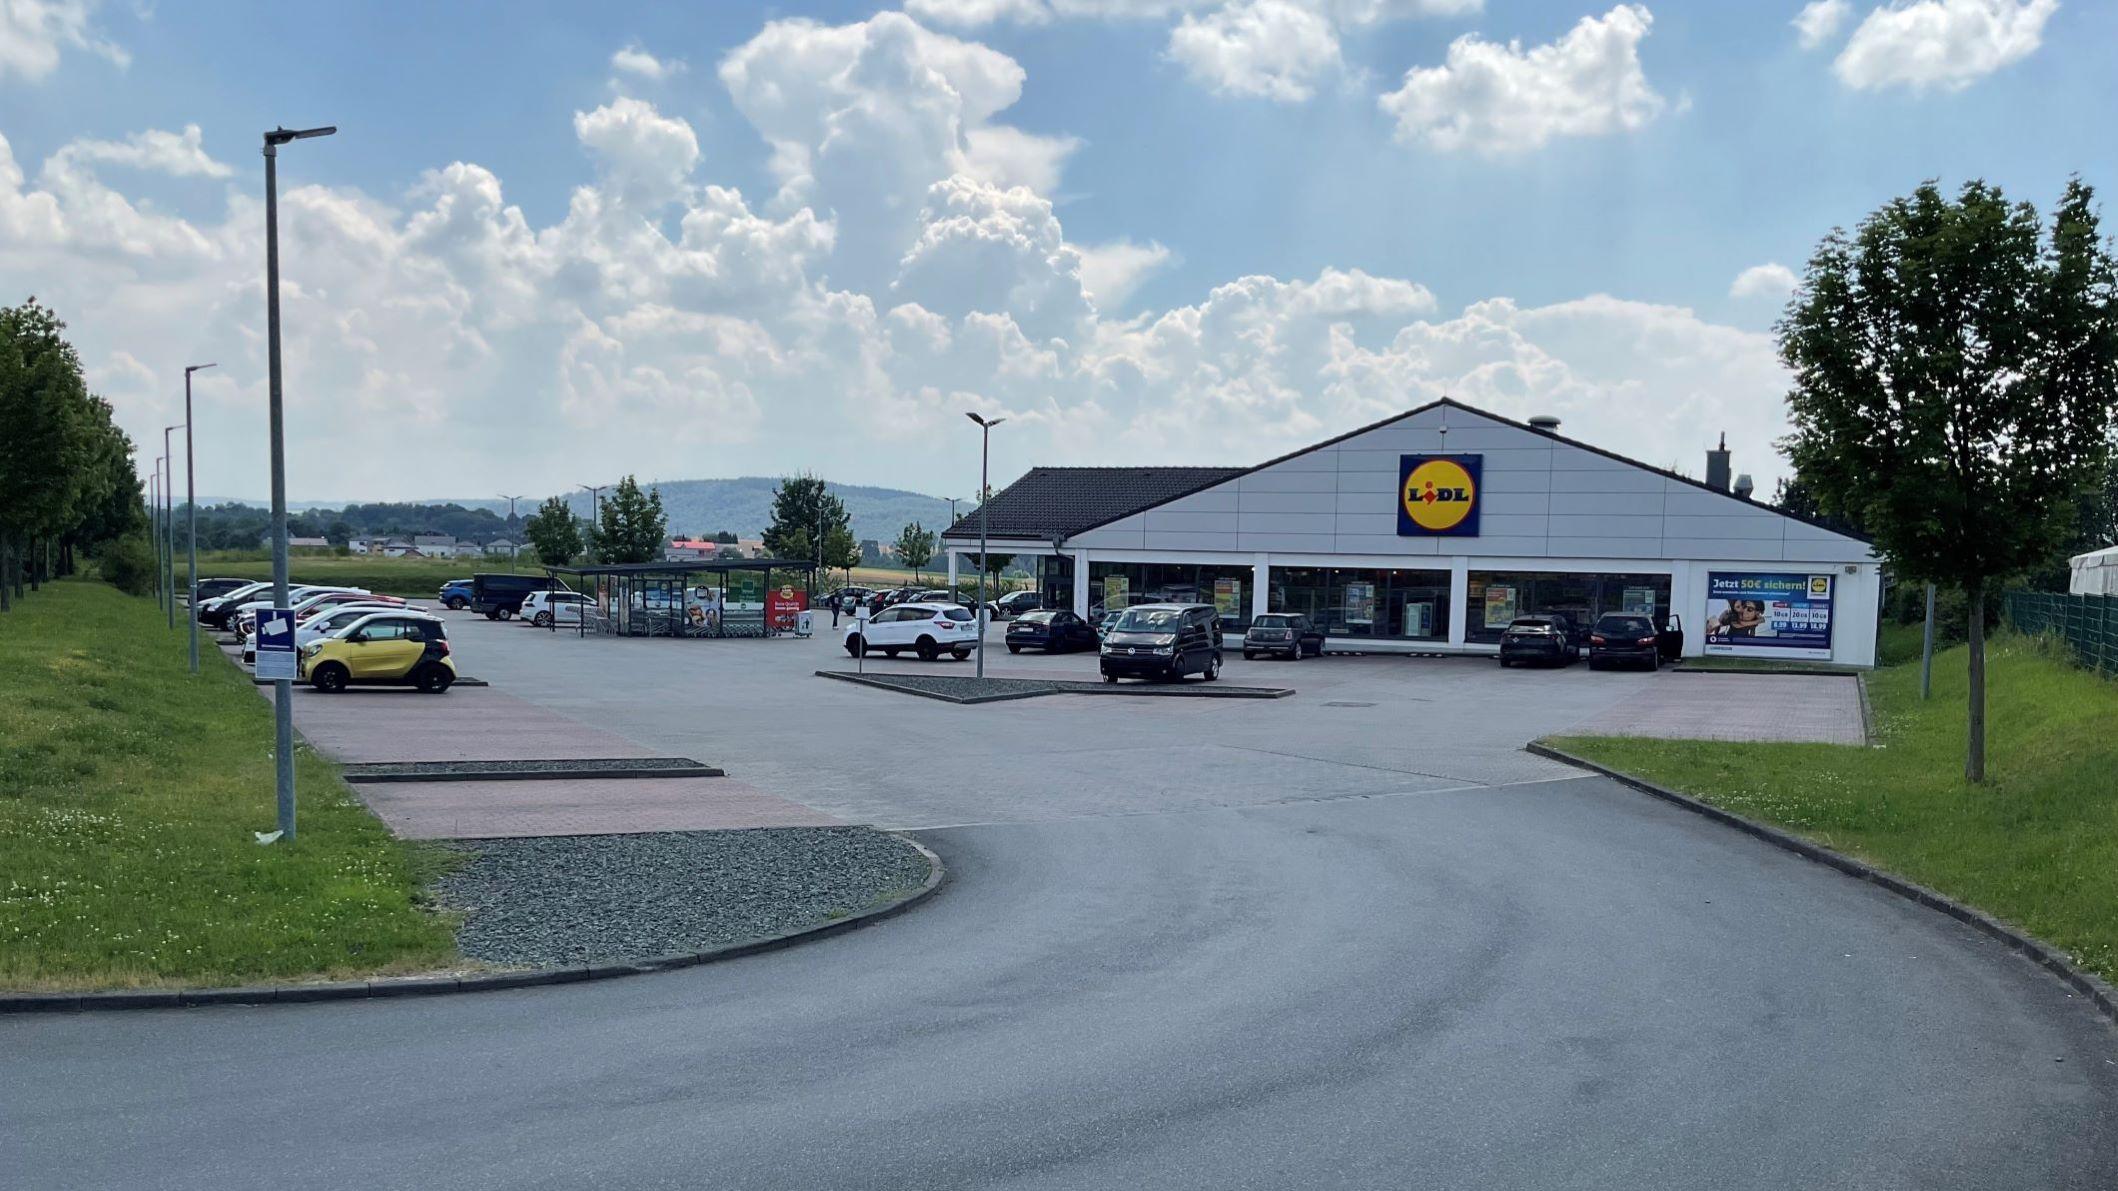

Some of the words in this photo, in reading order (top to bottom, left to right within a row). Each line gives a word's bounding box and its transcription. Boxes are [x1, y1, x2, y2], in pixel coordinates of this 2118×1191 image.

[1713, 579, 1739, 588] Jetzt
[1741, 579, 1761, 588] 50€
[1764, 580, 1806, 590] sichern!
